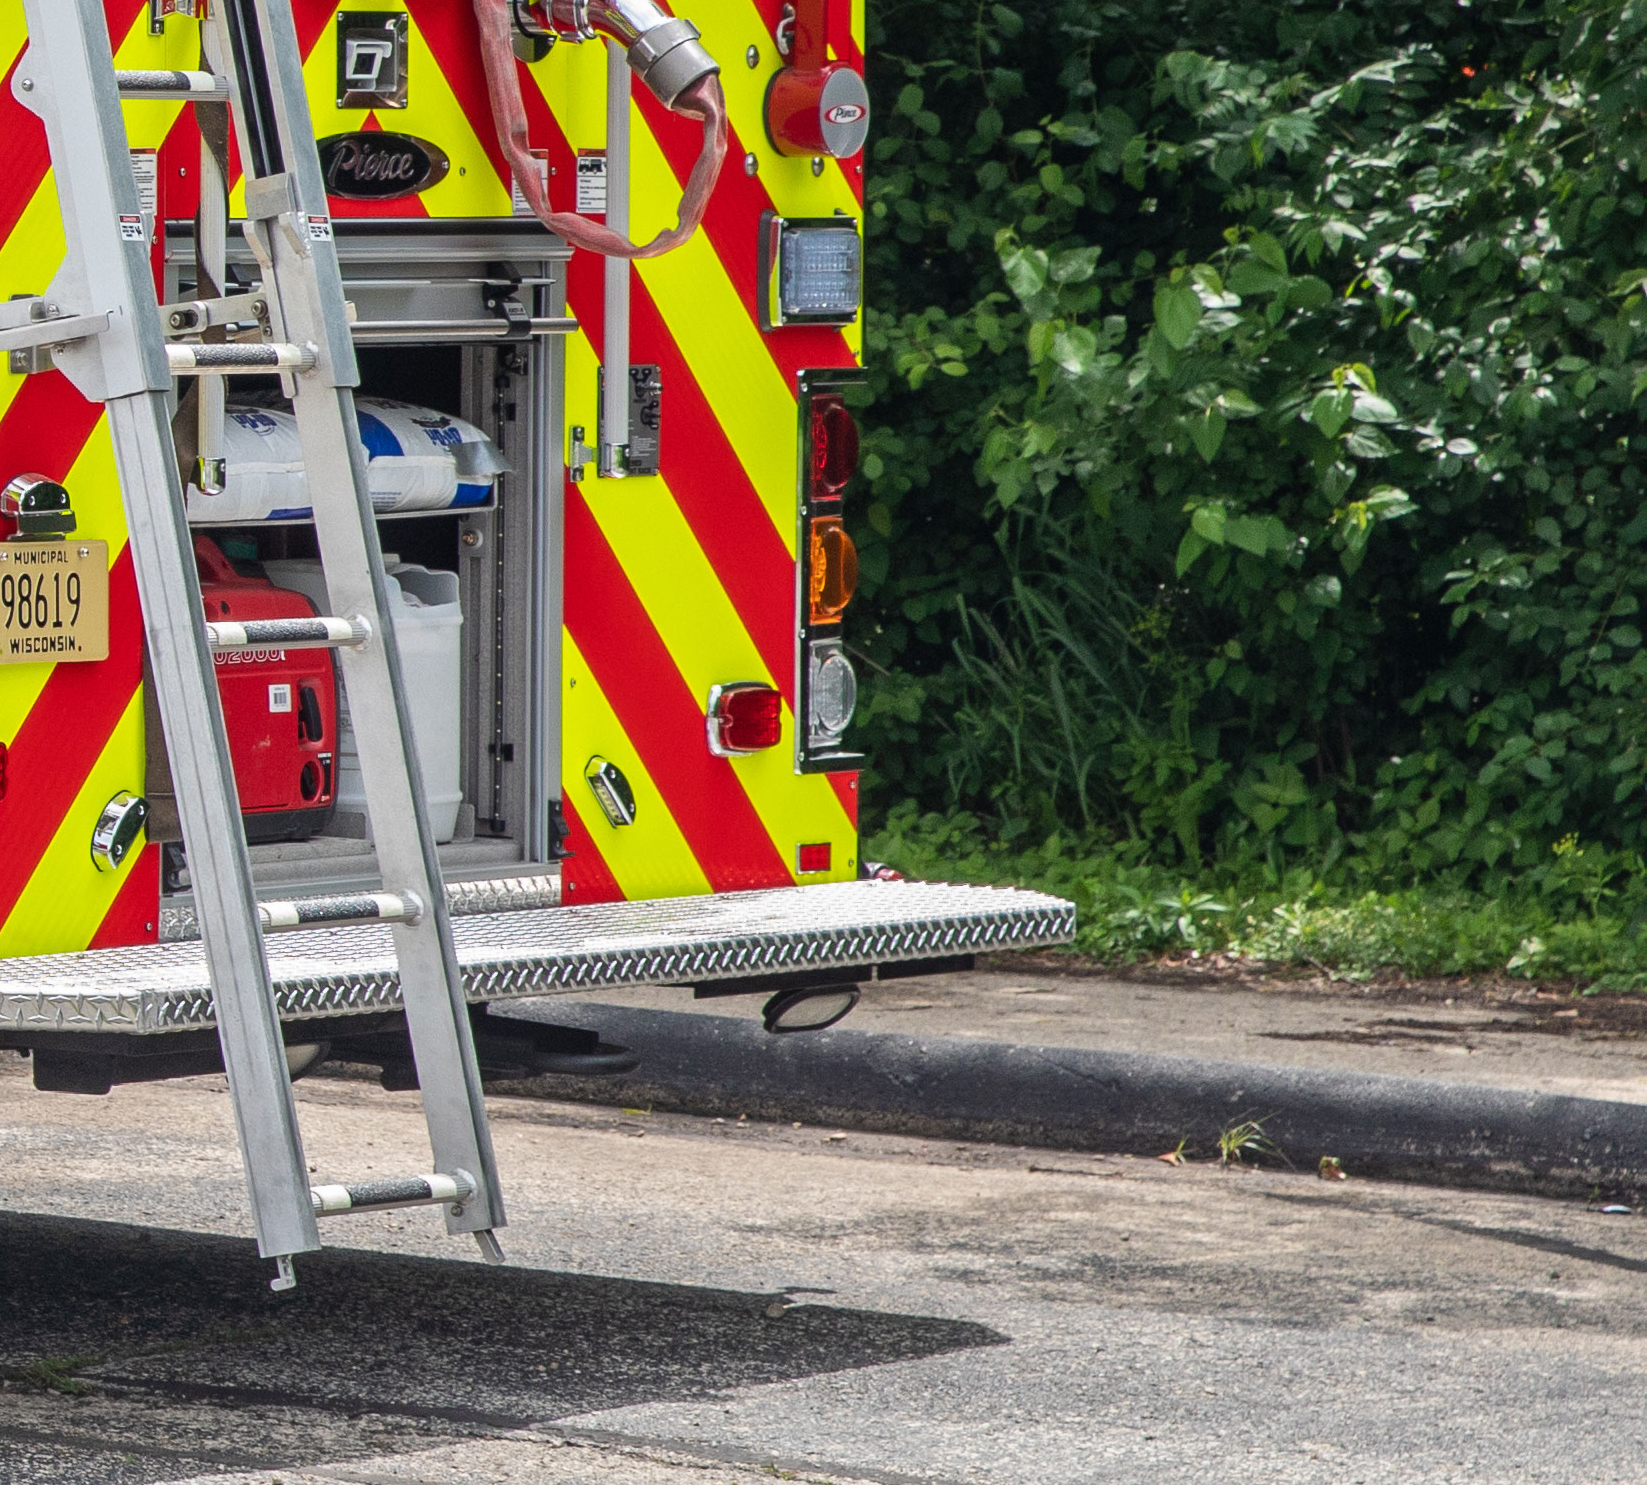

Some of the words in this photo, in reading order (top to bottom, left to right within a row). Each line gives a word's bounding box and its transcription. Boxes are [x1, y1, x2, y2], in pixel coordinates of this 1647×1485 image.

[327, 139, 414, 188] Pierce
[14, 550, 69, 565] MUNICIPAL
[1, 572, 81, 629] 98619
[9, 635, 76, 654] WISCONSIN
